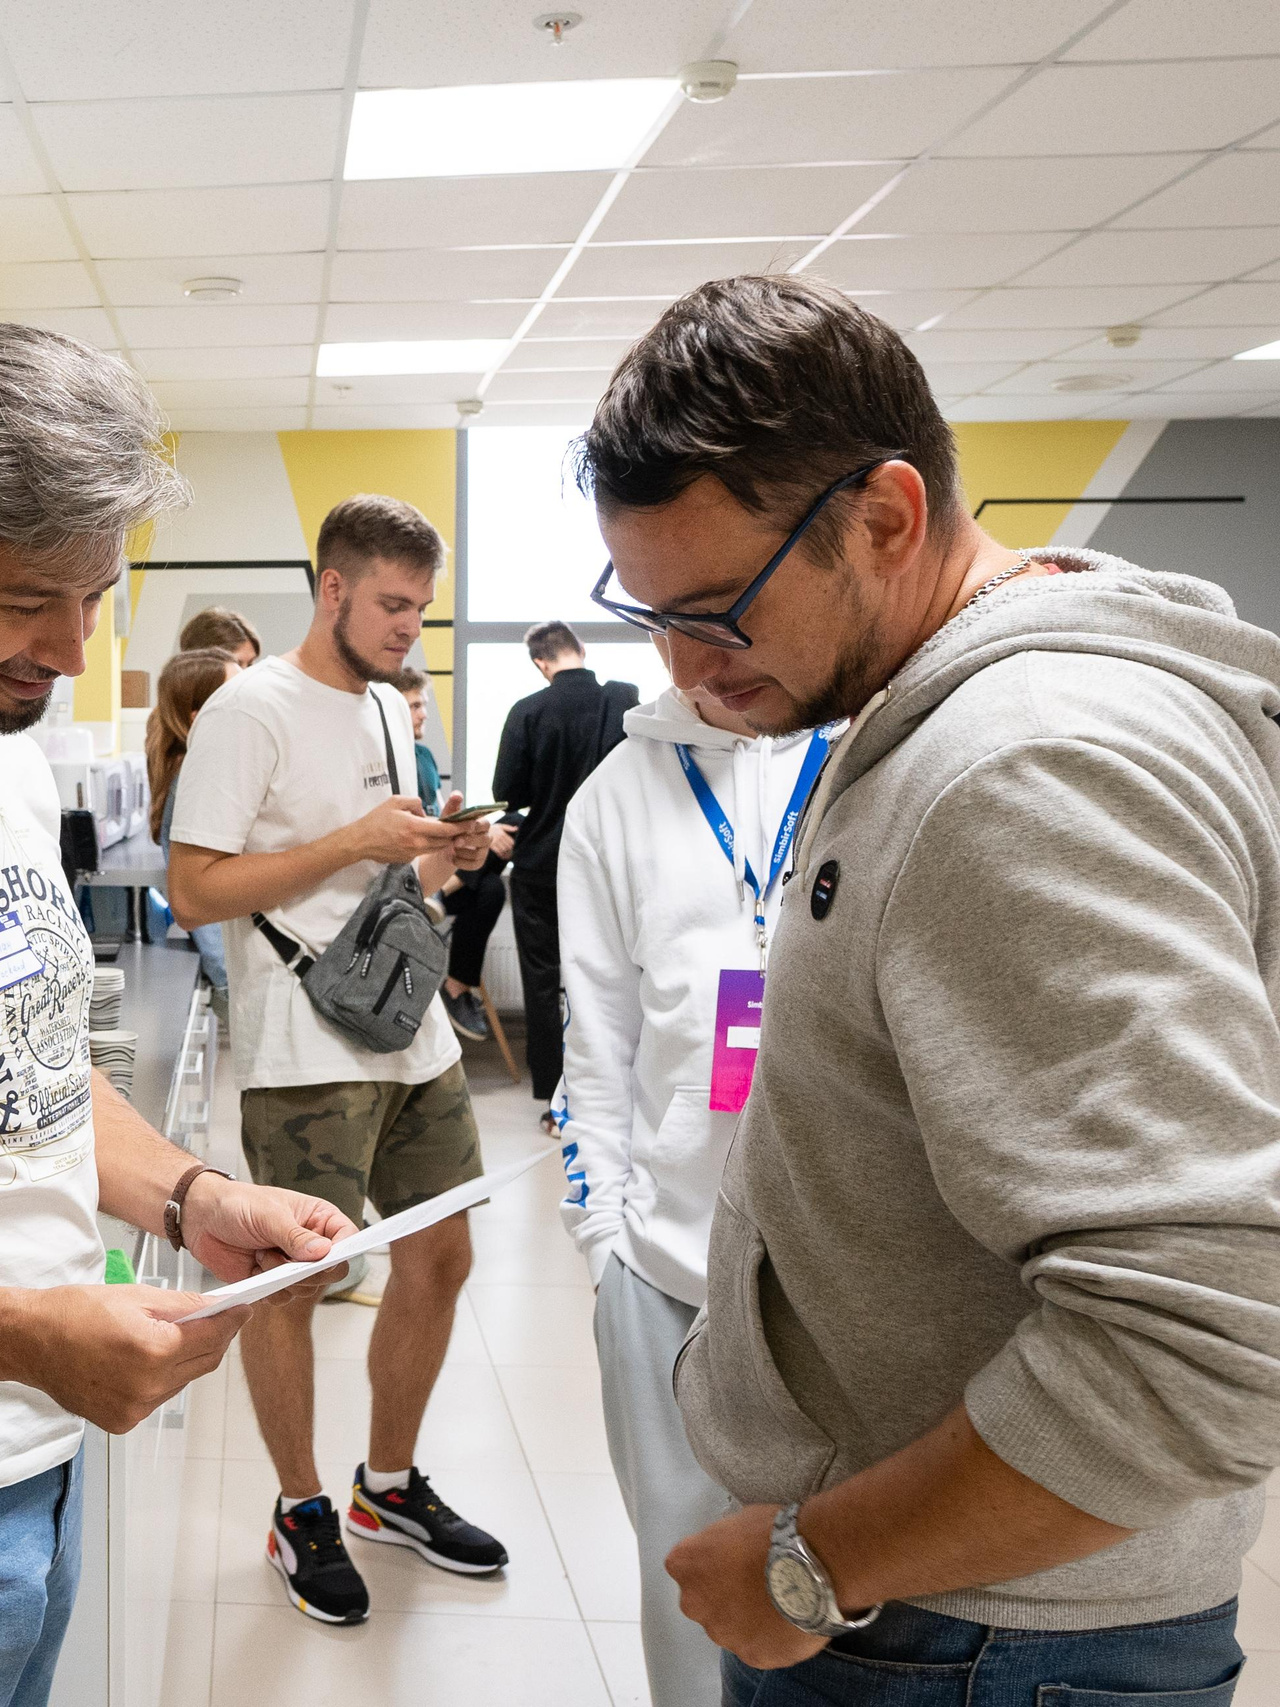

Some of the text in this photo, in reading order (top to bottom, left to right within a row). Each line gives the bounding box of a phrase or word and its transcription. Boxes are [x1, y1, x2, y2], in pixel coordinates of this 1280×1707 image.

[773, 811, 799, 864] SimbirSoft
[24, 904, 84, 953] RACING
[21, 983, 52, 1037] Great
[36, 1023, 78, 1054] ASSOCIATION
[28, 1077, 70, 1117] Official
